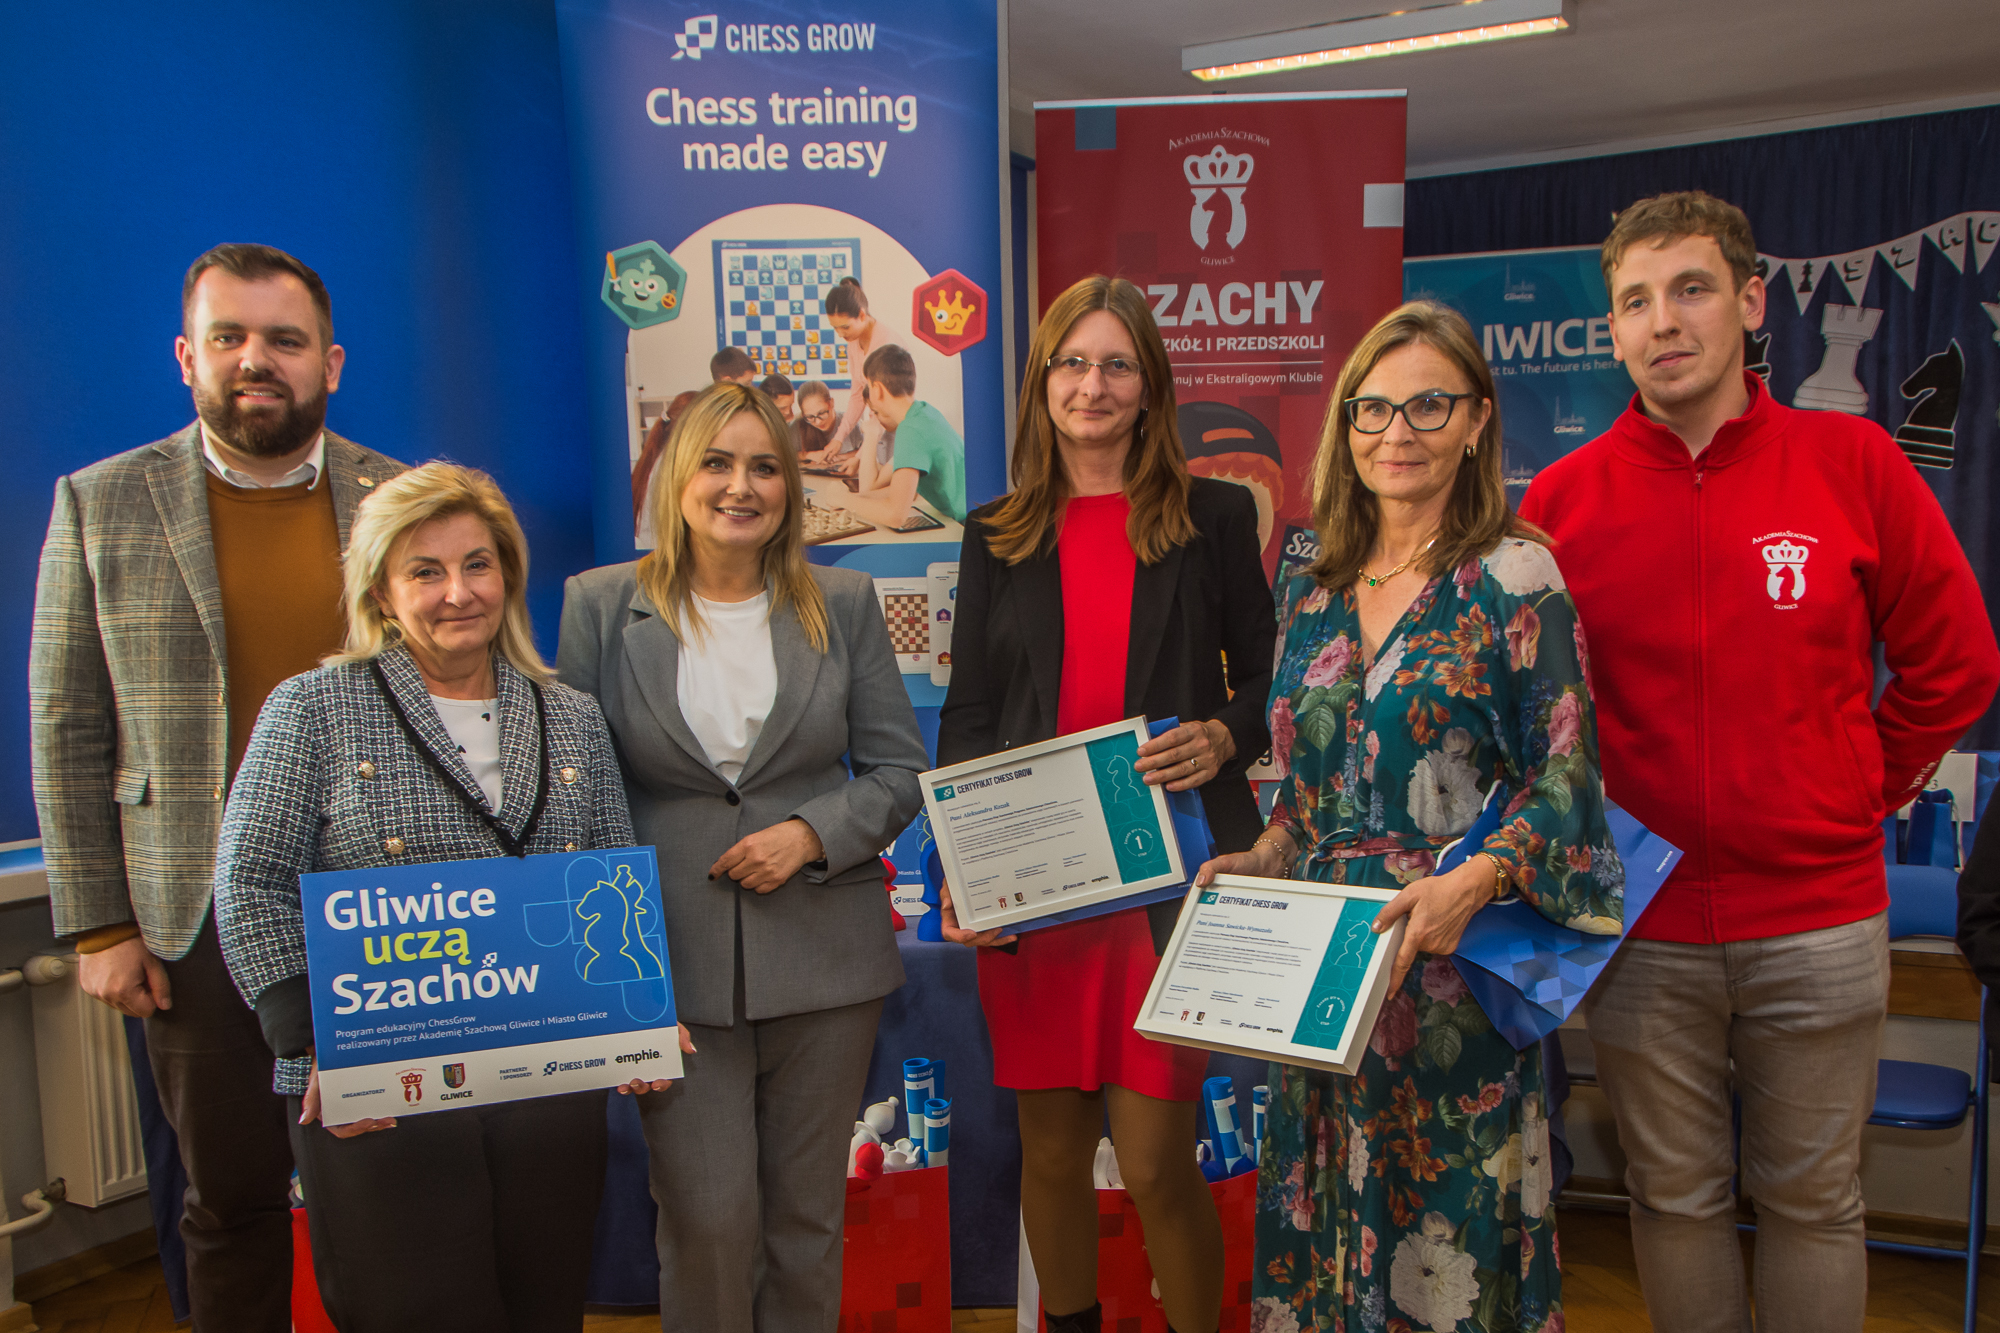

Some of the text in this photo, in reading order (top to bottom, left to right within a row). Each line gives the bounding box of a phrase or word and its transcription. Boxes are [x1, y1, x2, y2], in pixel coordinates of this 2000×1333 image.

[725, 22, 876, 52] CHESS GROW
[645, 86, 918, 132] Chess training
[683, 134, 887, 177] made easy
[1200, 255, 1235, 265] GLIWICE
[1141, 280, 1325, 328] ZACHY
[1162, 335, 1325, 352] ZKÓŁ I PRZEDSZKOLI
[1483, 316, 1615, 361] IWICE
[1503, 365, 1518, 376] tu.
[1520, 363, 1541, 374] The
[1543, 361, 1580, 373] future
[1582, 361, 1592, 371] is
[1594, 359, 1620, 370] here
[1195, 375, 1204, 384] w
[1206, 372, 1287, 385] Ekstraligowym
[1289, 371, 1323, 383] Klubie
[957, 767, 1033, 794] CERTYFIKAT CHESS GROW
[1135, 835, 1143, 850] 1
[324, 882, 496, 931] Gliwice
[1219, 896, 1289, 910] CERTYFIKAT CHESS GROW
[363, 926, 472, 966] uczą
[332, 953, 540, 1016] Szachów
[1326, 1003, 1334, 1019] 1
[335, 1015, 477, 1039] Program edukacyjny ChessGrow
[336, 1010, 608, 1051] realizowany przez Akademię Szachową Gliwice i Miasto Gliwice
[558, 1057, 606, 1072] CHESS GROW
[614, 1048, 663, 1065] emphie.
[499, 1066, 528, 1075] PARTNERZY
[503, 1071, 533, 1080] SPONSORZY
[341, 1088, 386, 1099] ORGANIZATORZY
[440, 1090, 473, 1101] GLIWICE
